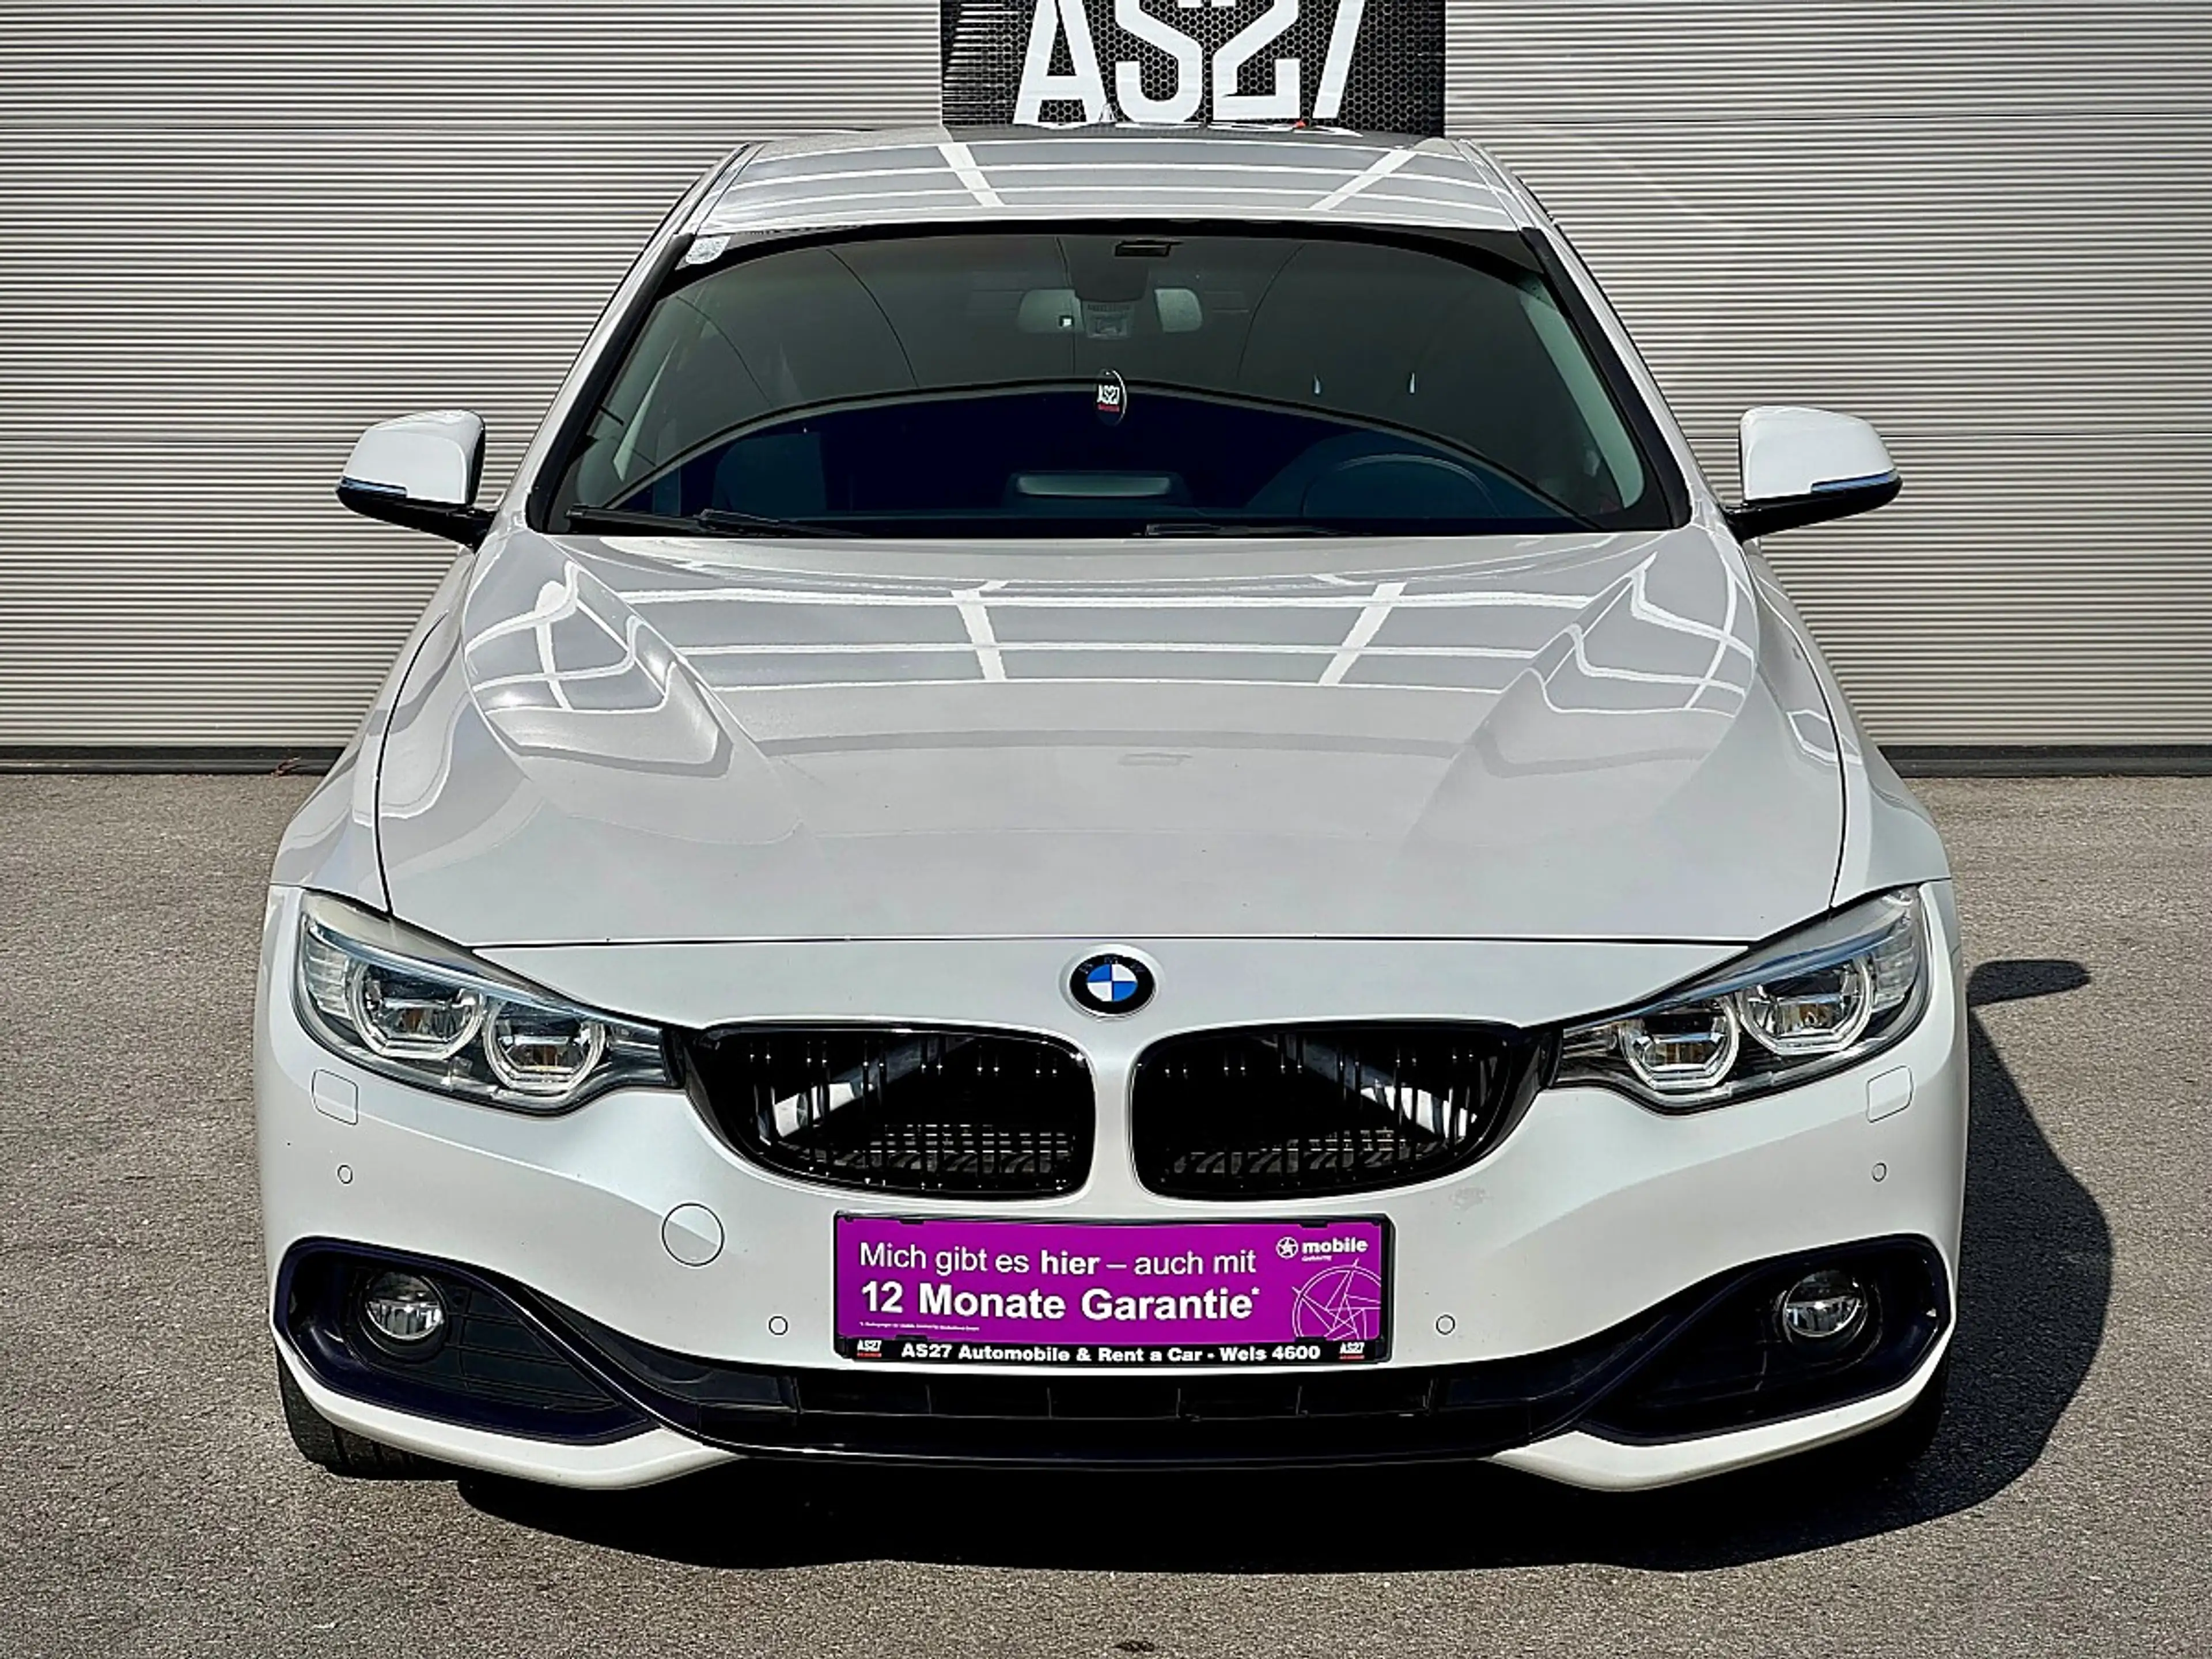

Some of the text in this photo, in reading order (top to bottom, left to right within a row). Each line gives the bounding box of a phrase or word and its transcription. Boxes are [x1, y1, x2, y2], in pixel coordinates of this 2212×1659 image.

[1302, 1237, 1369, 1254] mobile
[861, 1243, 926, 1268] Mich
[935, 1246, 987, 1276] gibt
[995, 1254, 1029, 1273] es
[1041, 1249, 1101, 1275] hier
[1134, 1251, 1203, 1275] auch
[1213, 1249, 1256, 1274] mit
[862, 1281, 903, 1313] 12
[919, 1283, 1066, 1319] Monate
[902, 1343, 952, 1358] AS27
[958, 1344, 1070, 1362] Automobile
[1076, 1347, 1092, 1361] &
[1098, 1347, 1145, 1361] Rent
[1150, 1351, 1162, 1361] a
[1167, 1347, 1203, 1361] Car
[1218, 1346, 1267, 1361] Wels
[1271, 1346, 1320, 1359] 4600
